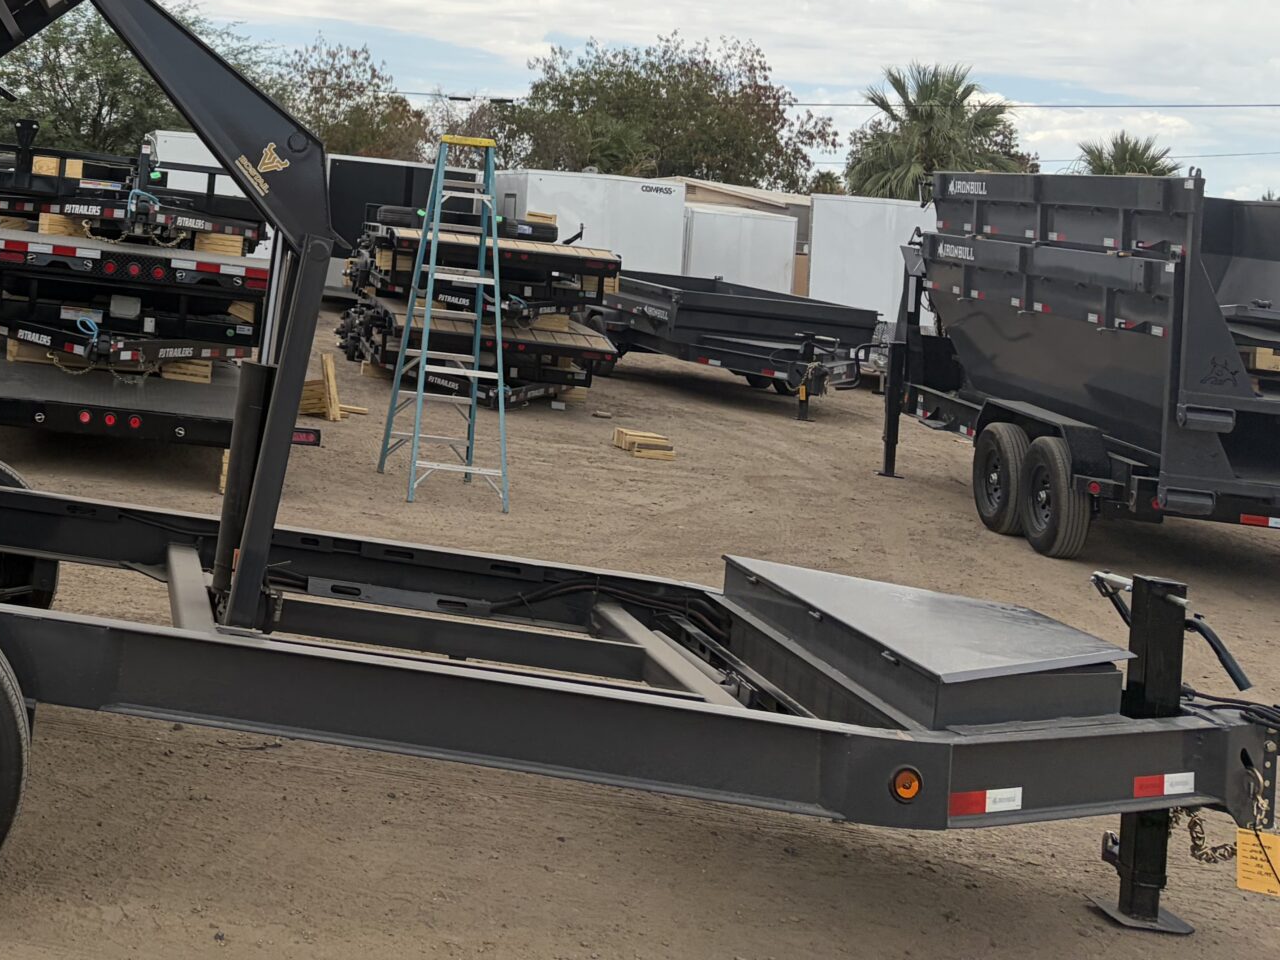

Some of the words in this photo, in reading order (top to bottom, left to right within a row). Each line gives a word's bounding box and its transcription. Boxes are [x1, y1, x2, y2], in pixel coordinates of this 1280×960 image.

[641, 184, 673, 196] COMPASS
[955, 181, 987, 195] IRONBULL
[943, 244, 974, 260] IRONBULL
